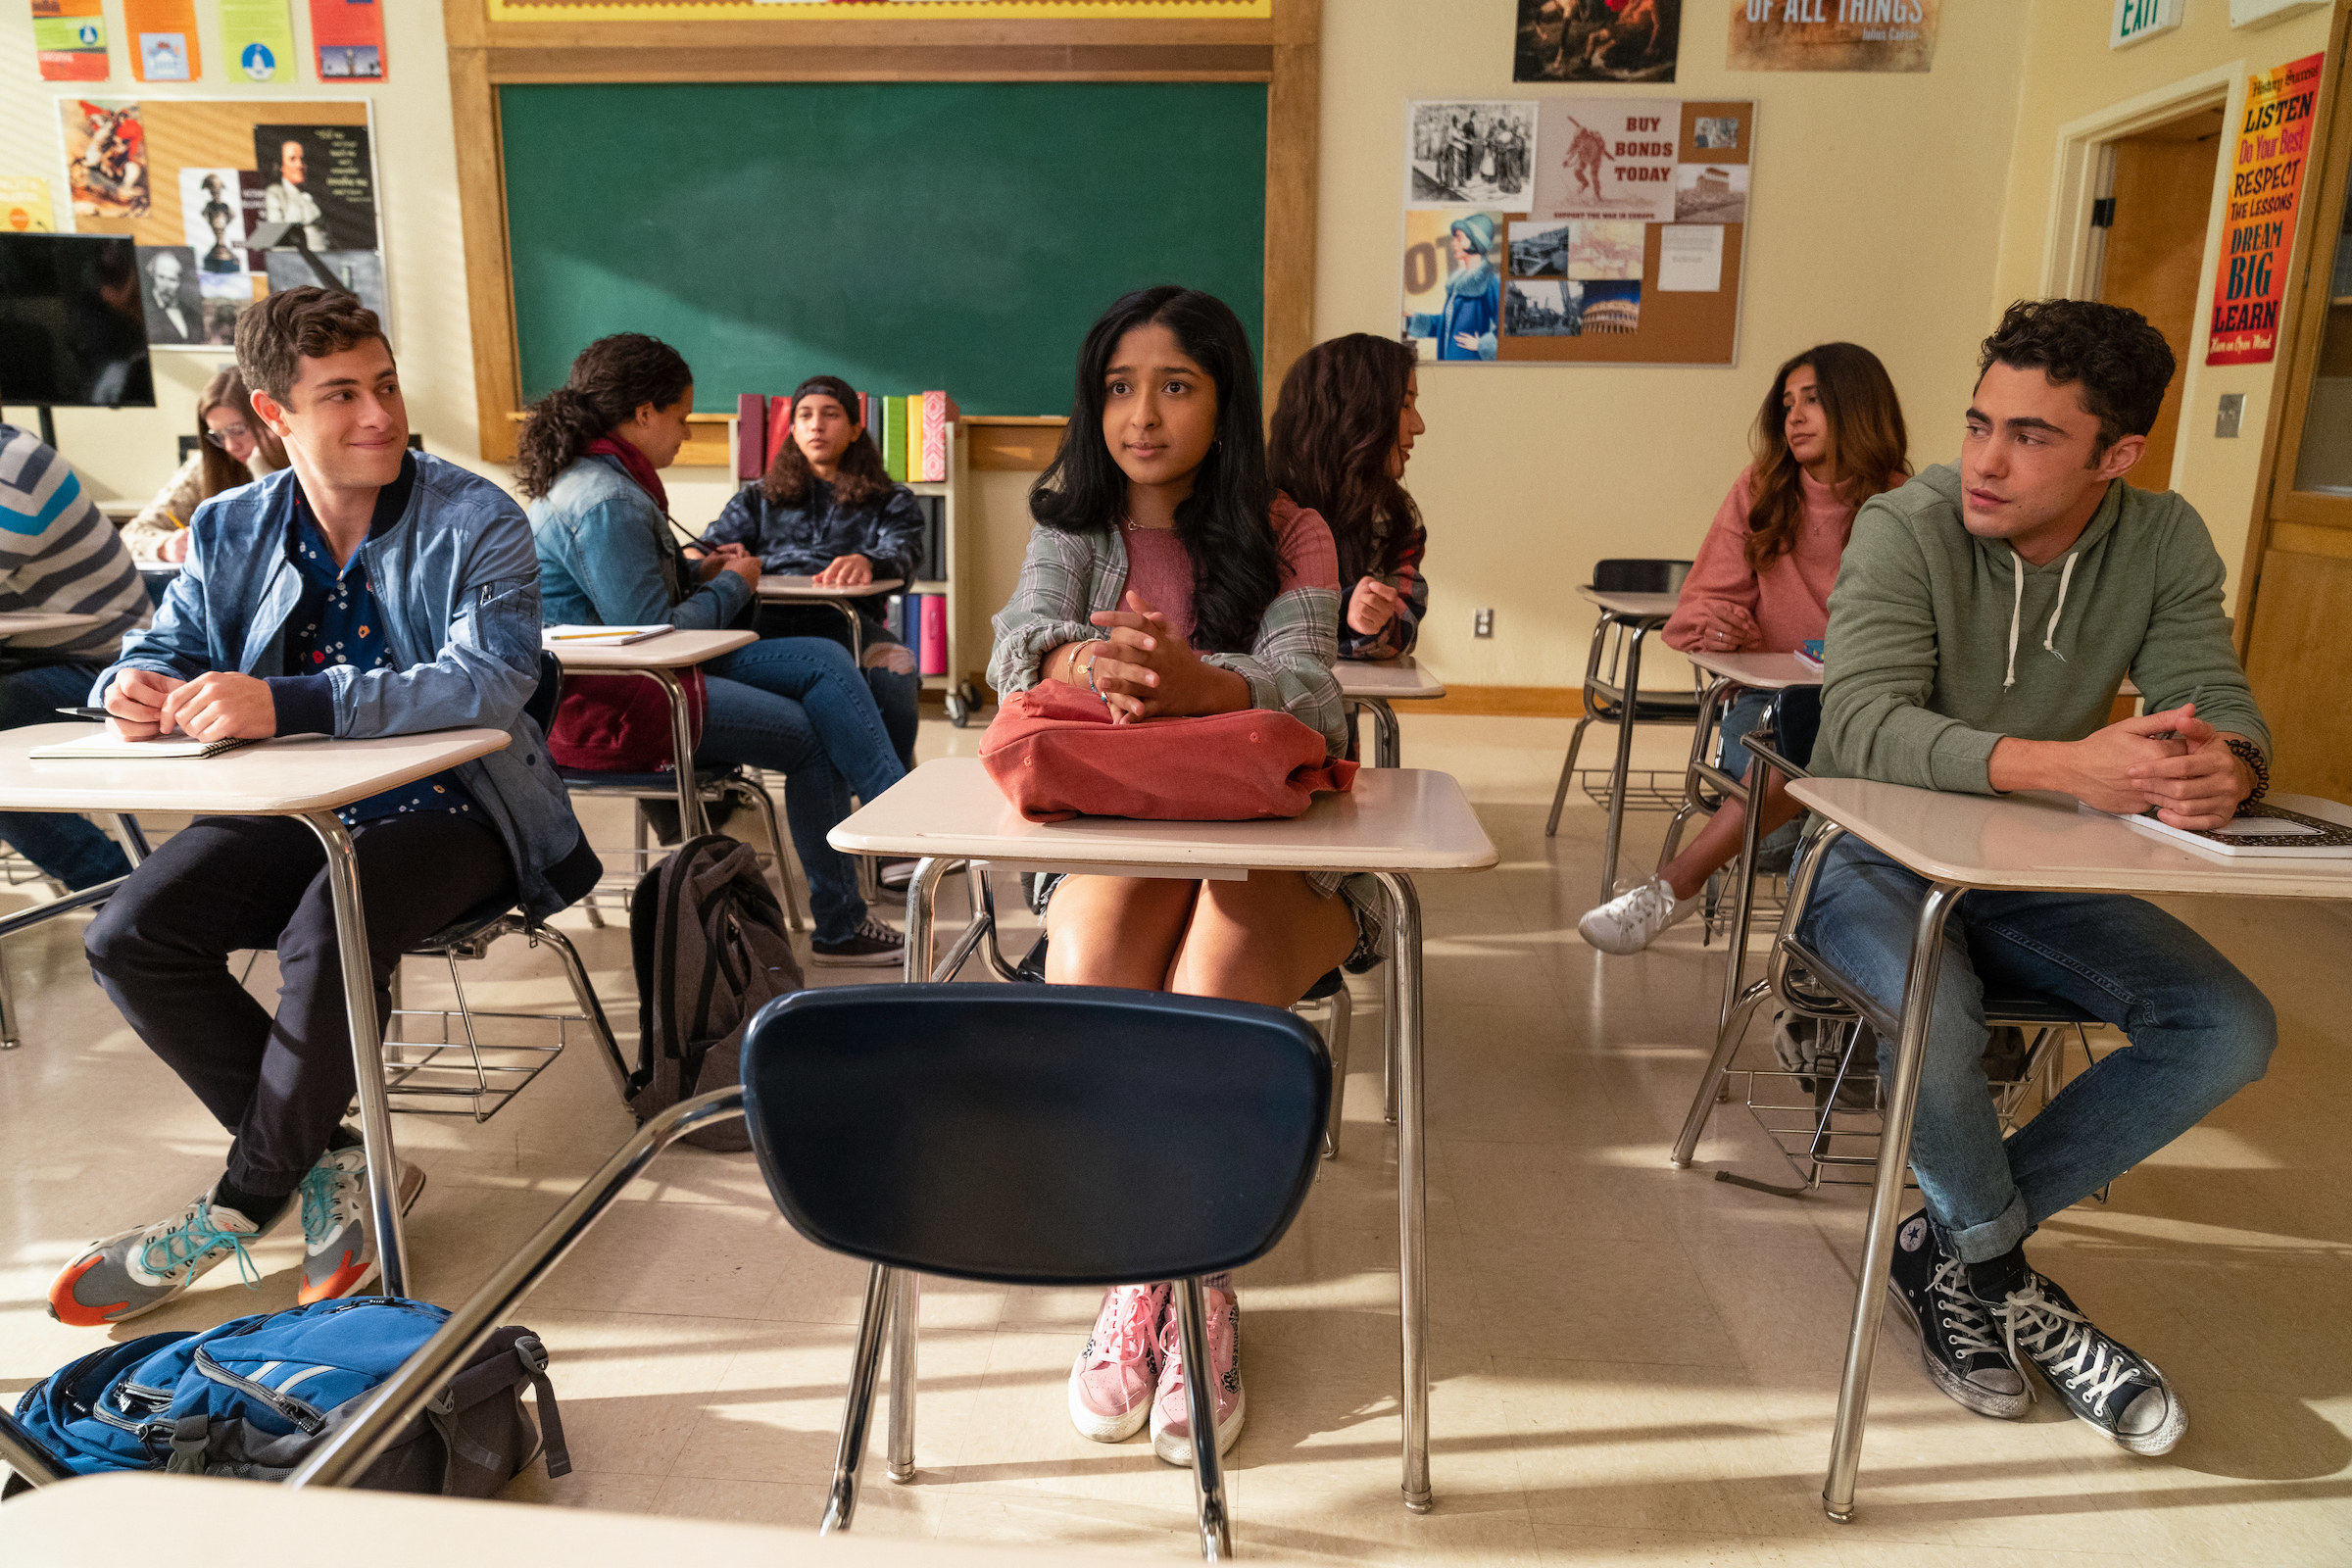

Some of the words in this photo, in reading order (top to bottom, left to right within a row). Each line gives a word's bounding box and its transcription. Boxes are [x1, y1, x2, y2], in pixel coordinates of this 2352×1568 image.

[1746, 0, 1774, 23] OF
[1783, 0, 1827, 23] ALL
[1838, 0, 1923, 24] THINGS
[1626, 116, 1661, 132] BUY
[2243, 90, 2314, 134] LISTEN
[1614, 141, 1673, 157] BONDS
[2239, 139, 2254, 166] Do
[2256, 134, 2278, 162] Your
[2279, 124, 2305, 156] Best
[1614, 167, 1671, 182] TODAY
[2234, 159, 2301, 198] RESPECT
[2230, 202, 2248, 221] THE
[2250, 192, 2293, 218] LESSONS
[2230, 220, 2283, 255] DREAM
[2227, 251, 2273, 301] BIG
[2213, 301, 2278, 333] LEARN
